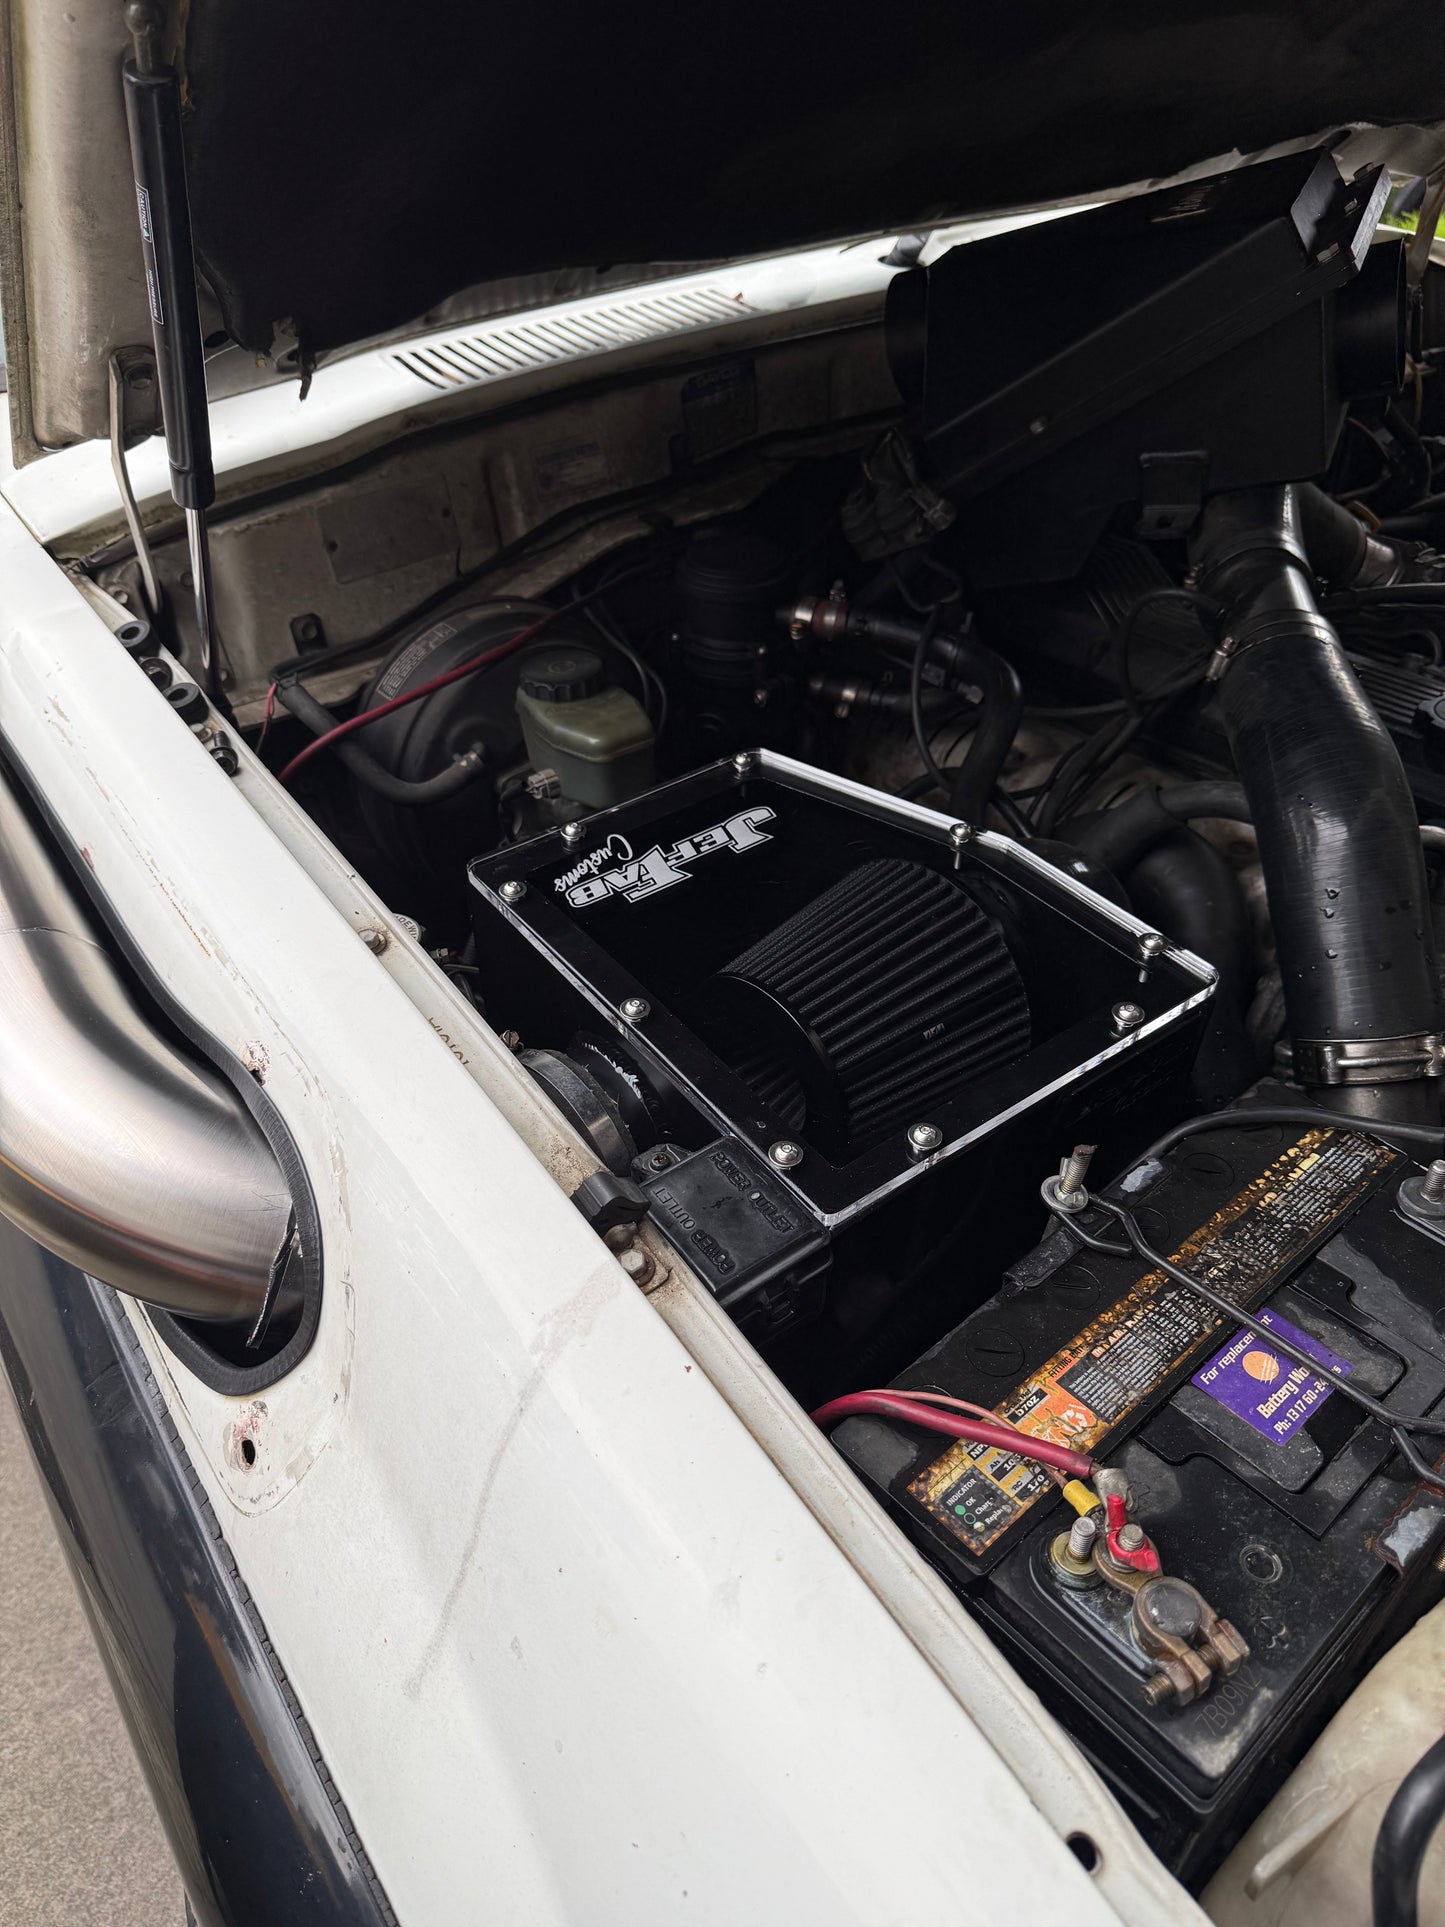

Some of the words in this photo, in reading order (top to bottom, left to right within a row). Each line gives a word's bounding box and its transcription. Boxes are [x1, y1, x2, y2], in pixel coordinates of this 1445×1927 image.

[554, 833, 634, 893] Customs
[708, 1153, 752, 1190] POWER
[748, 1190, 795, 1232] OUTLET
[653, 1188, 695, 1231] OUTLET
[691, 1233, 736, 1273] POWER
[1049, 1355, 1072, 1378] FITTING
[1200, 1366, 1220, 1385] For
[1256, 1380, 1300, 1419] Battery
[1273, 1418, 1292, 1435] Ph:
[1286, 1408, 1300, 1422] 13
[1294, 1400, 1308, 1414] 17
[989, 1459, 1001, 1470] Ah
[946, 1478, 977, 1507] INDICATOR
[965, 1496, 977, 1507] OK
[1012, 1480, 1023, 1491] RC
